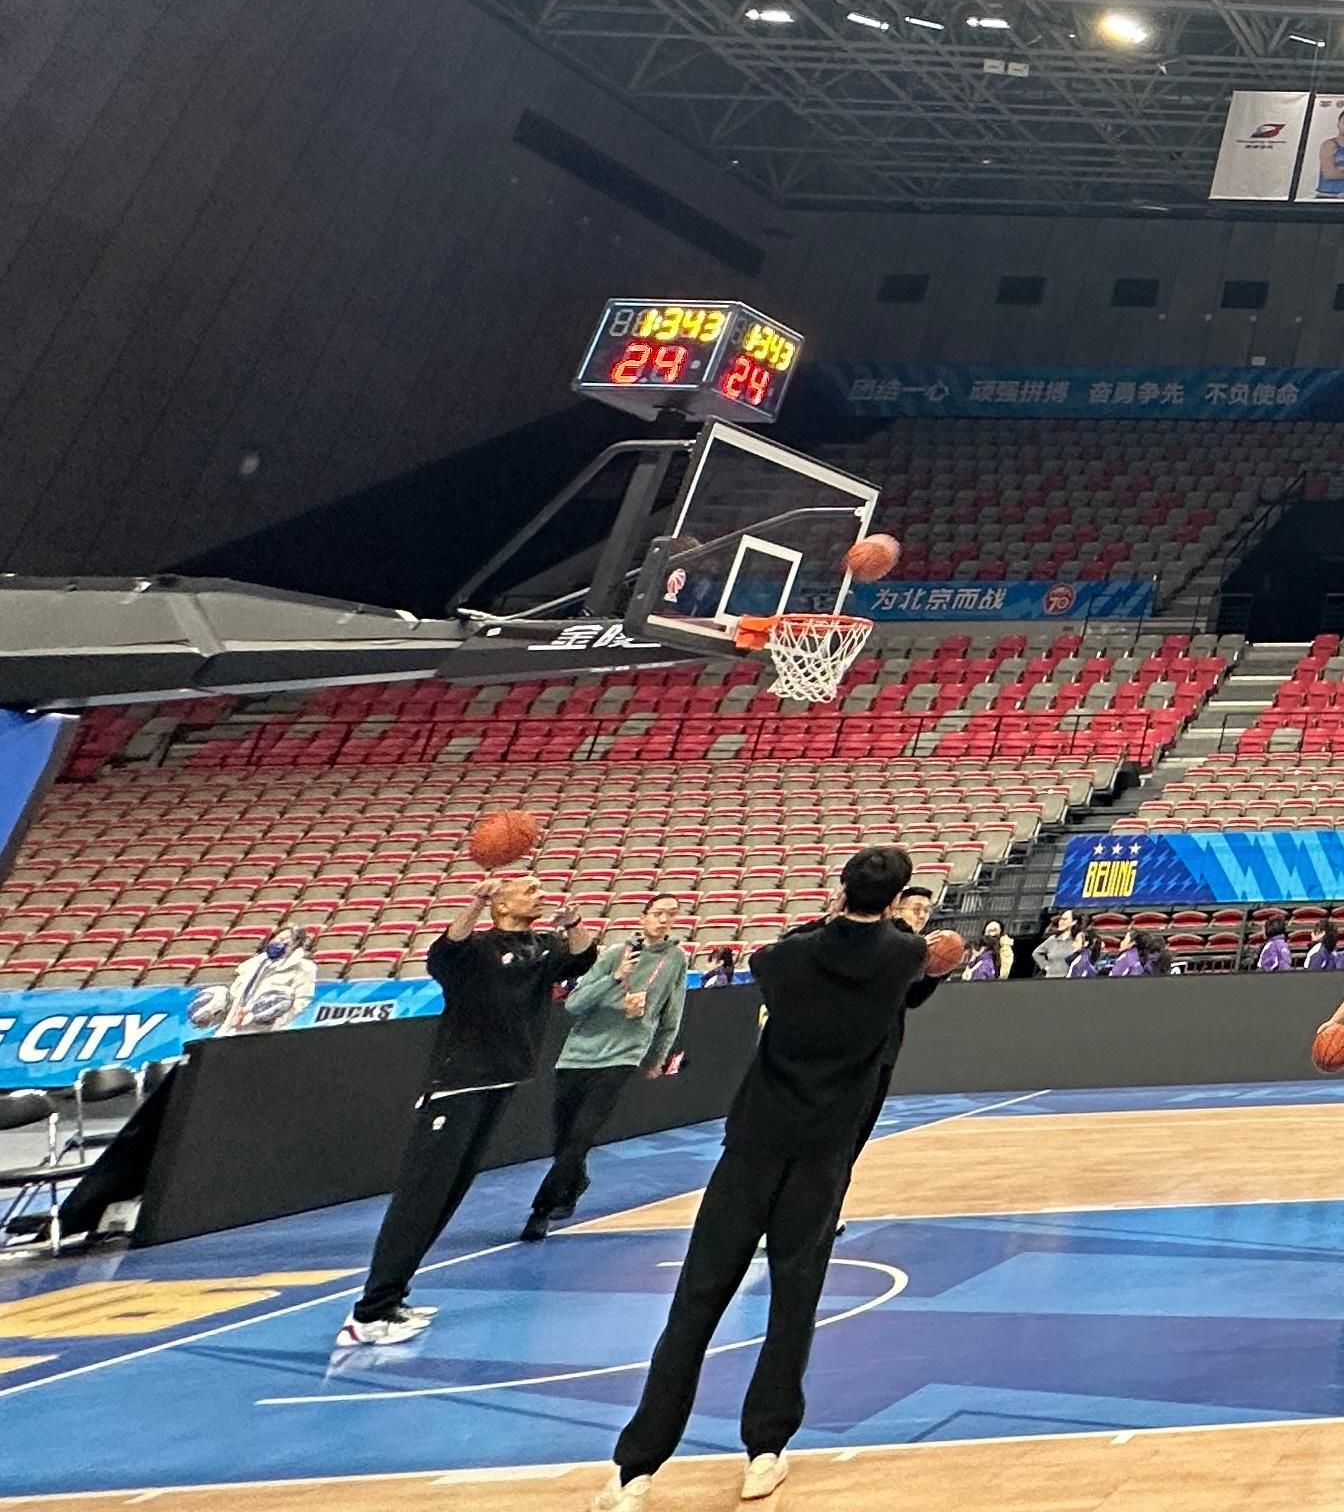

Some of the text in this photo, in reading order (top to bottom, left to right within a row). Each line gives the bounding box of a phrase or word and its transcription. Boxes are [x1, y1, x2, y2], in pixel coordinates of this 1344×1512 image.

[611, 342, 688, 384] 24
[722, 354, 770, 406] 24
[1204, 382, 1300, 406] 不负使命
[870, 587, 1005, 612] 为北京而战
[1082, 859, 1139, 899] BEIJING
[315, 1002, 395, 1024] DUCKS
[18, 1013, 169, 1063] CITY
